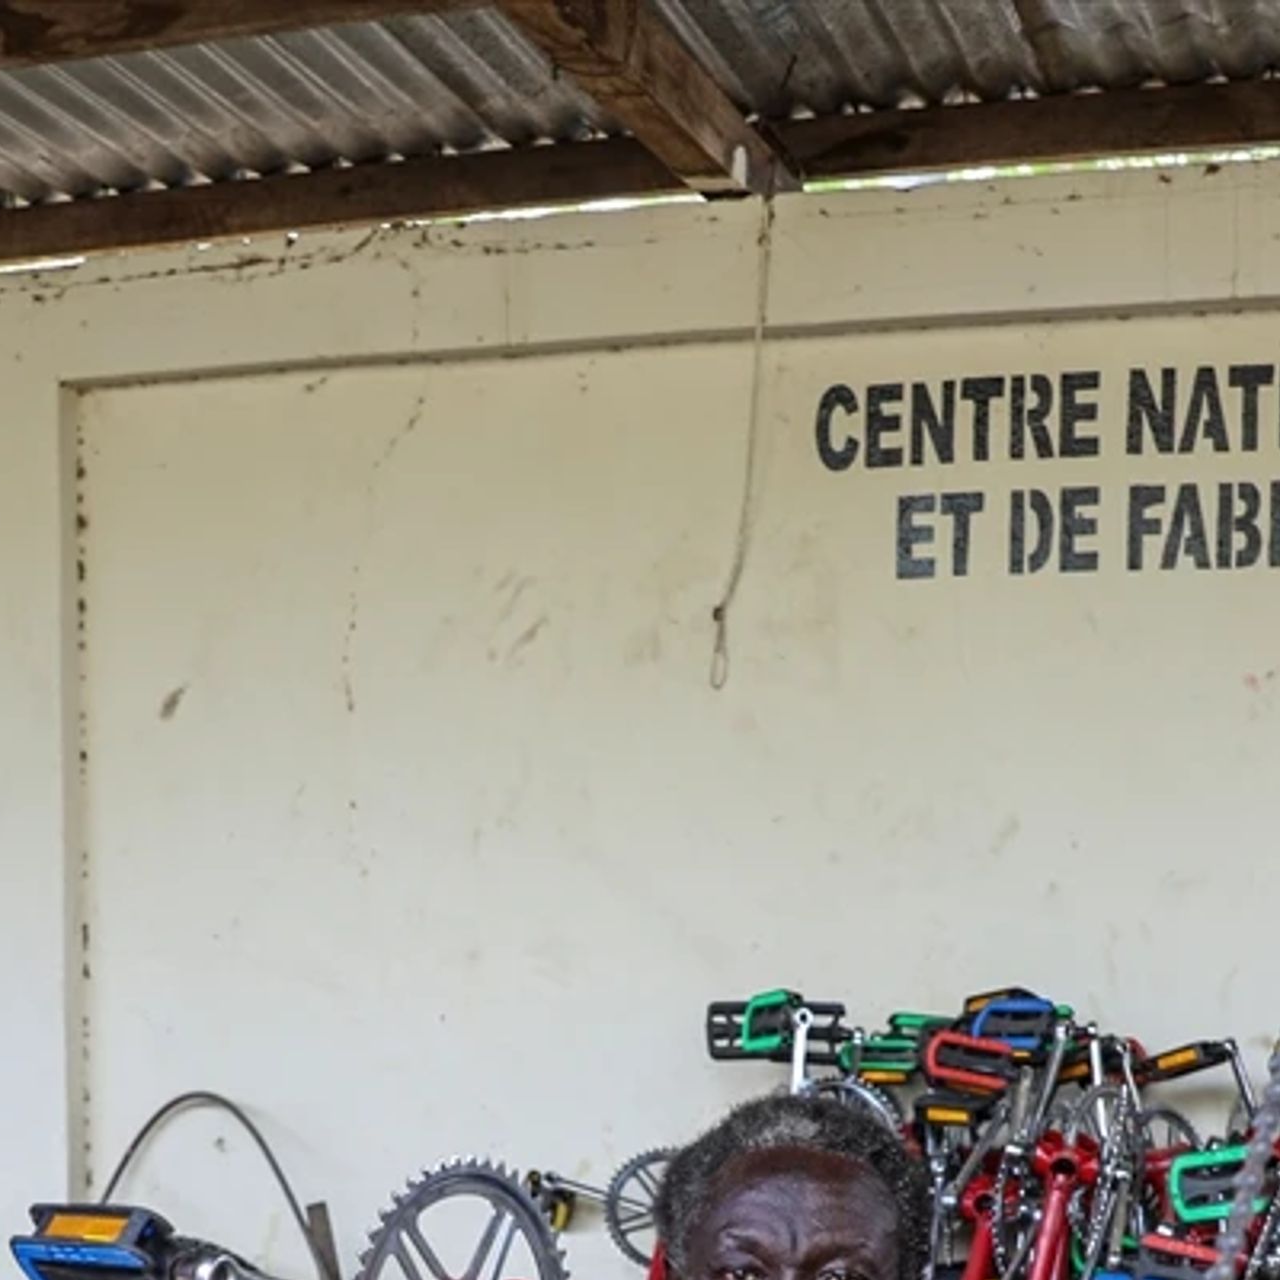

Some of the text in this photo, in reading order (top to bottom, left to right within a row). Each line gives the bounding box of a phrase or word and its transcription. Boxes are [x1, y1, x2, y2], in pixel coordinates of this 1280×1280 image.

[816, 370, 1101, 472] CENTRE
[895, 491, 984, 579] ET
[1009, 486, 1100, 574] DE
